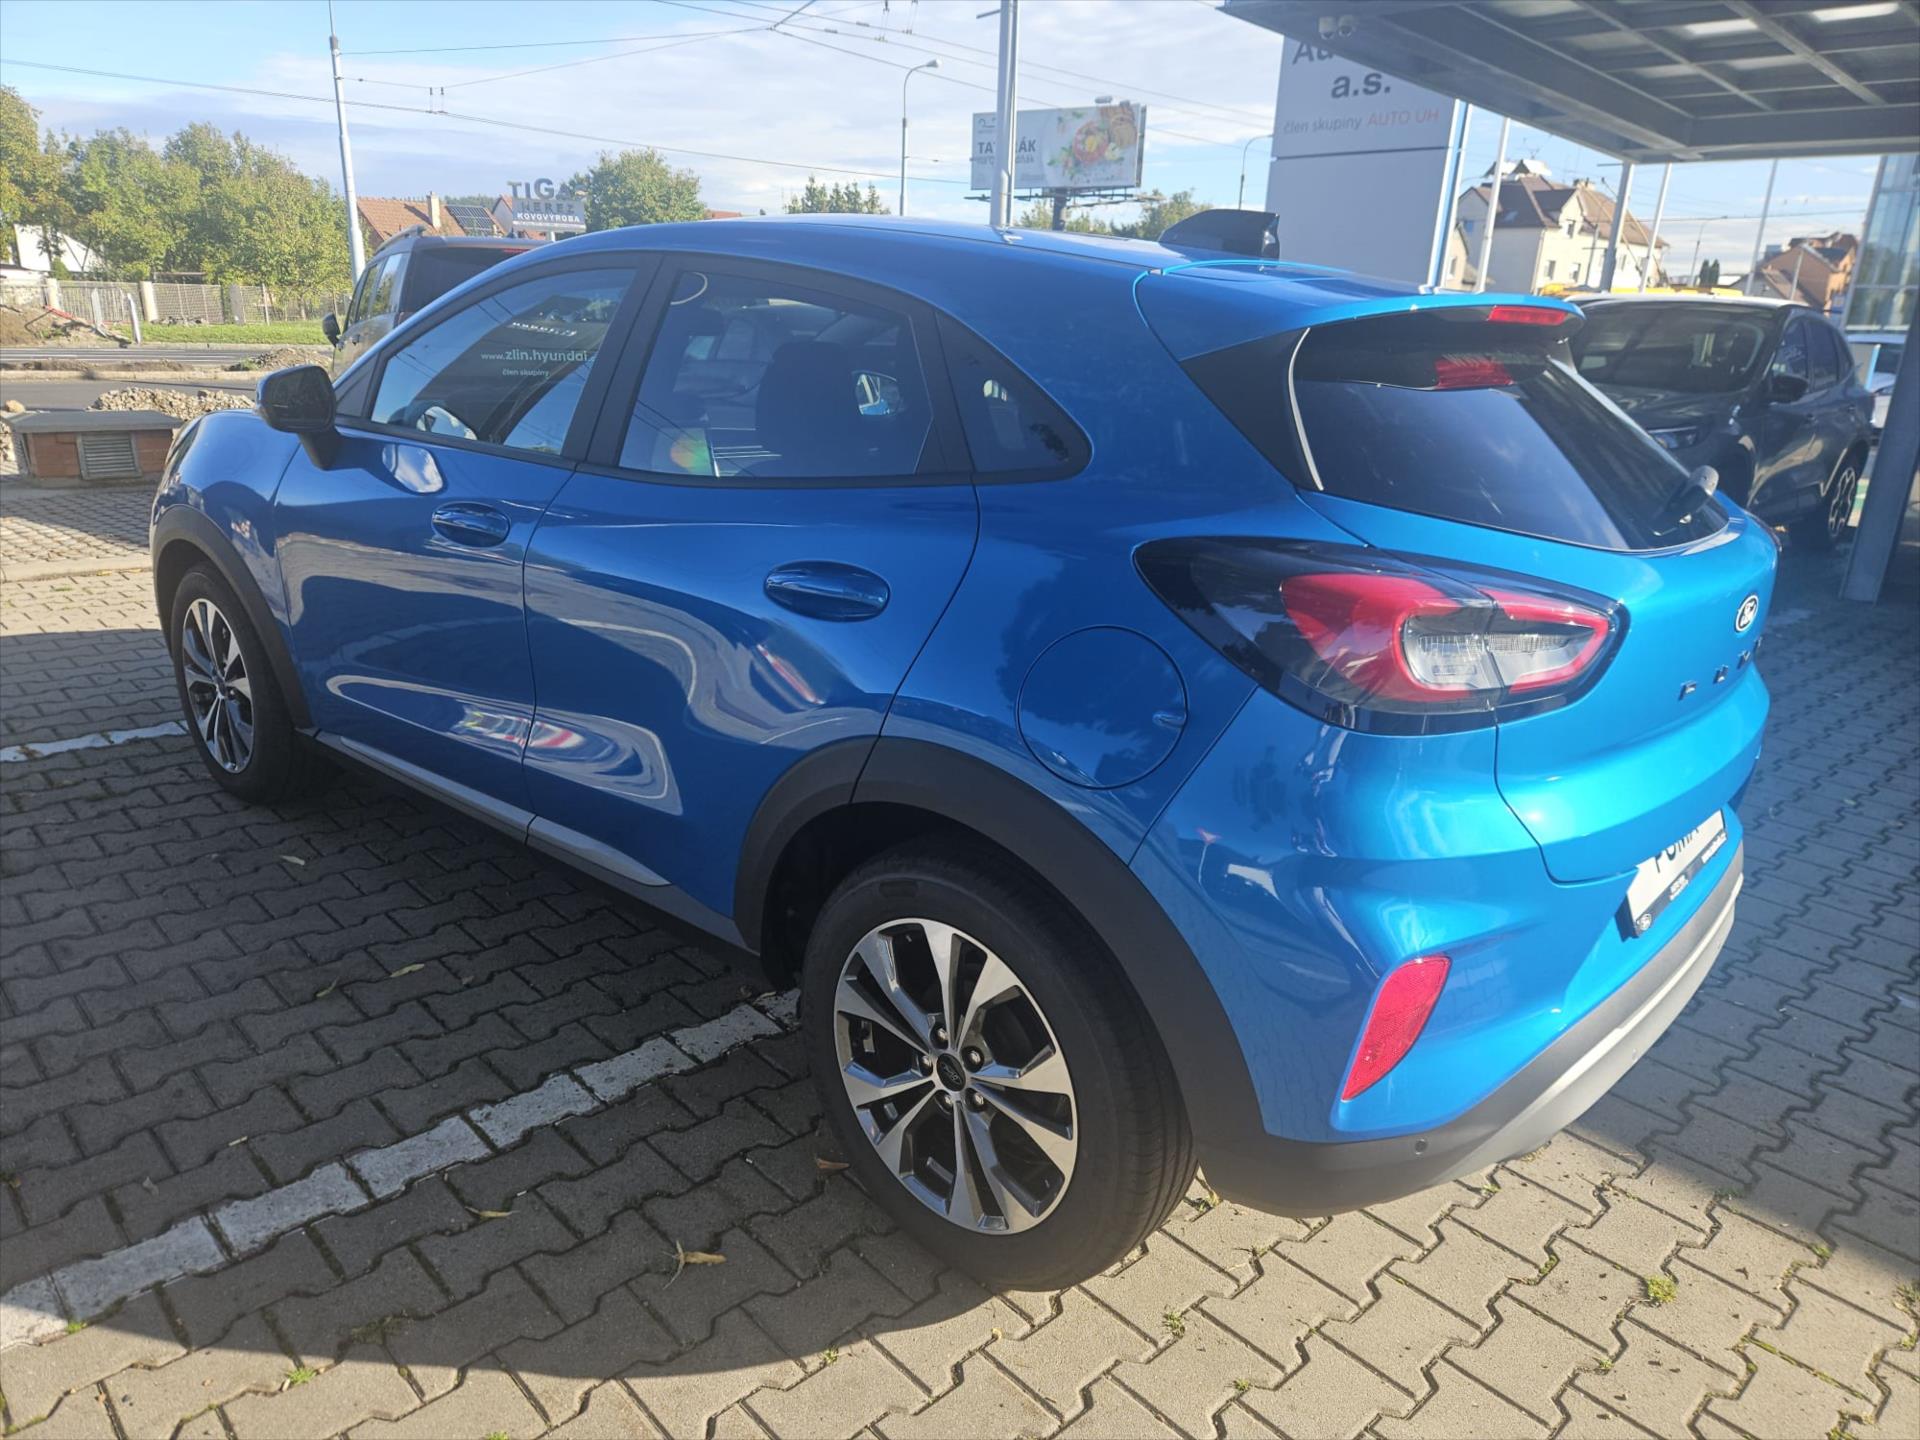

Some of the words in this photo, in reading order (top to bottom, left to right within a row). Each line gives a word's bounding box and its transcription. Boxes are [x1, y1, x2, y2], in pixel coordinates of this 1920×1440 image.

[1331, 72, 1391, 98] a.s.
[1312, 115, 1362, 132] skupiny
[1367, 110, 1411, 127] AUTO
[1415, 107, 1440, 124] UH
[516, 212, 580, 222] KOVOVÝROBA
